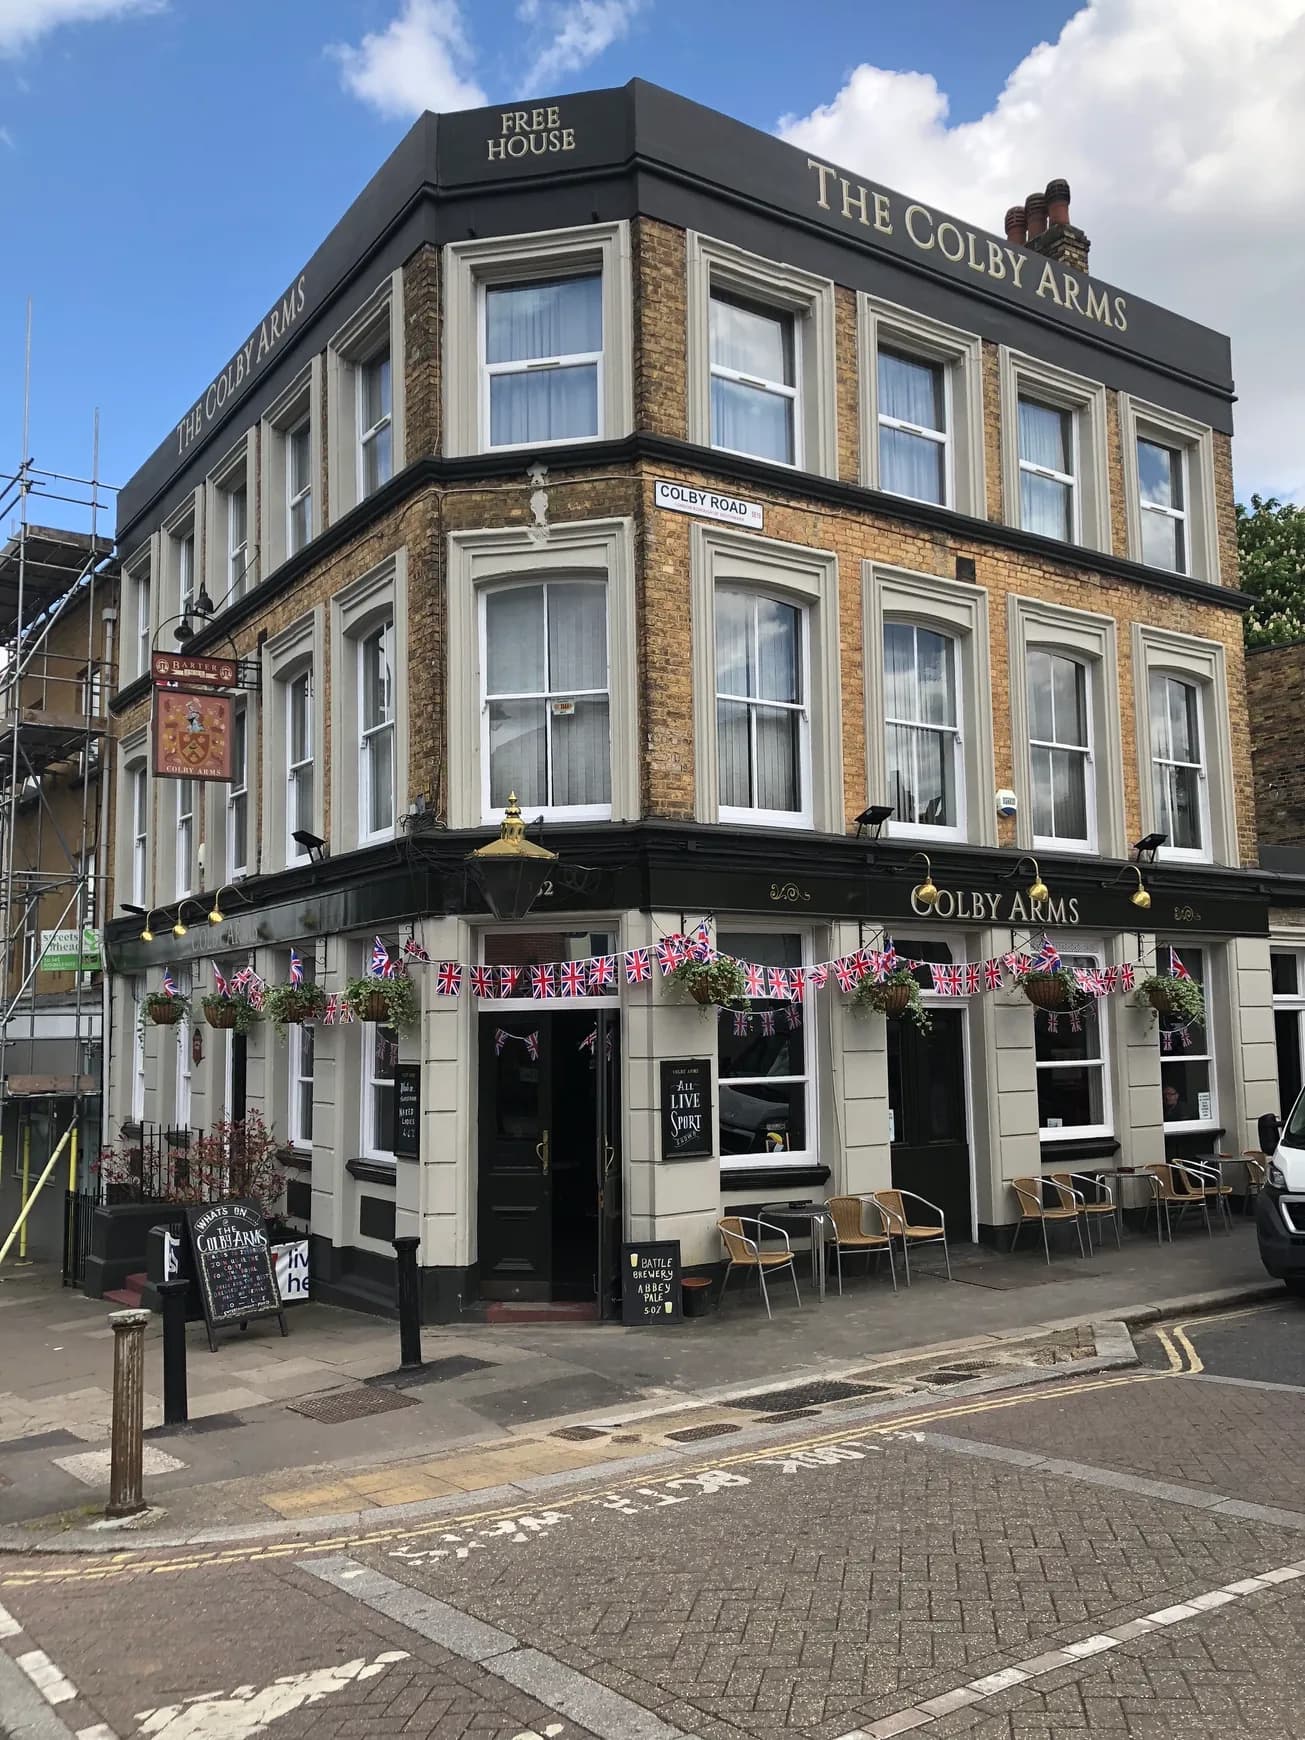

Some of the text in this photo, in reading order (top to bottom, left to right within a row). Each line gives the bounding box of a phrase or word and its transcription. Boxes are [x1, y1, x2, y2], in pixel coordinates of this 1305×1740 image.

[501, 106, 561, 135] FREE
[487, 128, 576, 161] HOUSE
[807, 158, 1128, 332] THE COLBY ARMS
[176, 275, 306, 456] THE COLBY ARMS
[660, 485, 707, 505] COLBY
[710, 496, 747, 515] ROAD
[172, 661, 217, 671] BARTER
[910, 884, 1080, 925] COLBY ARMS
[677, 1080, 694, 1091] ALL
[671, 1093, 700, 1109] LIVE
[670, 1110, 702, 1137] SPORT
[217, 1225, 237, 1235] THE
[197, 1229, 267, 1252] COLBY ARMS
[641, 1258, 673, 1268] BATTLE
[632, 1269, 673, 1281] BREWERY
[637, 1283, 671, 1294] ABBEY
[643, 1292, 664, 1303] PALE
